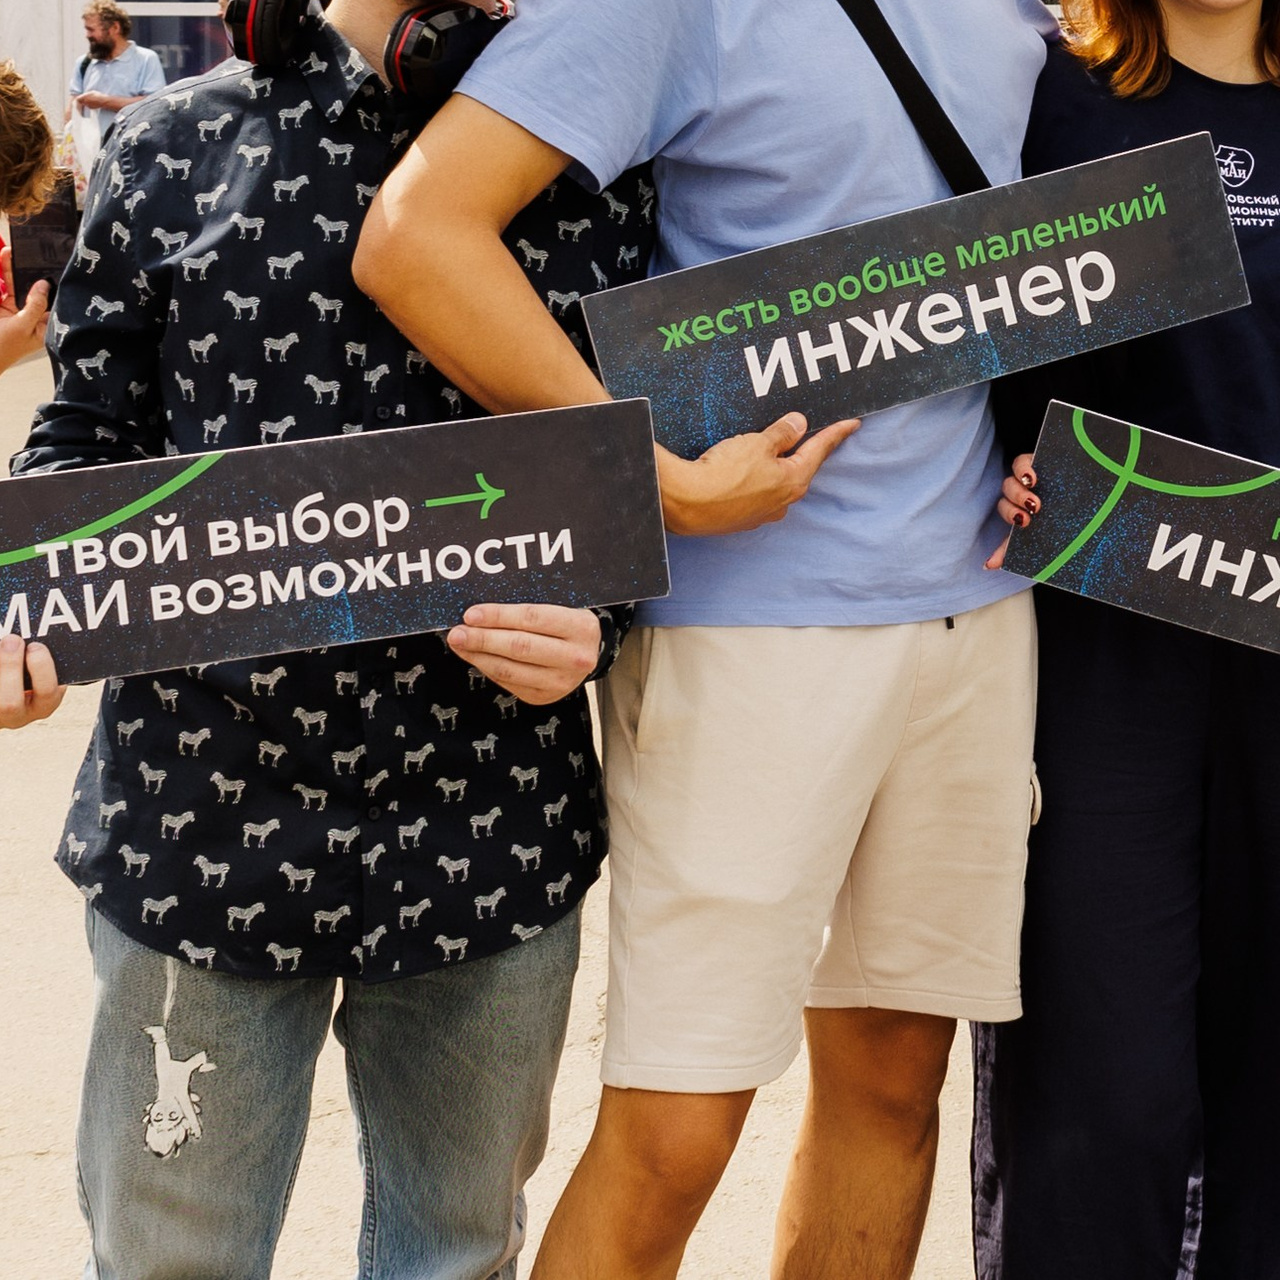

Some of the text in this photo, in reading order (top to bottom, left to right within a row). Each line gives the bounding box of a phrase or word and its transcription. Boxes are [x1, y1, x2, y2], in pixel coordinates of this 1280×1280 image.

[1225, 194, 1280, 206] ОВСКИЙ
[1230, 217, 1275, 227] ТИТУТ
[658, 184, 1167, 351] жесть вообще маленький
[743, 250, 1116, 398] инженер
[34, 491, 410, 578] твой выбор
[150, 528, 574, 621] возможности
